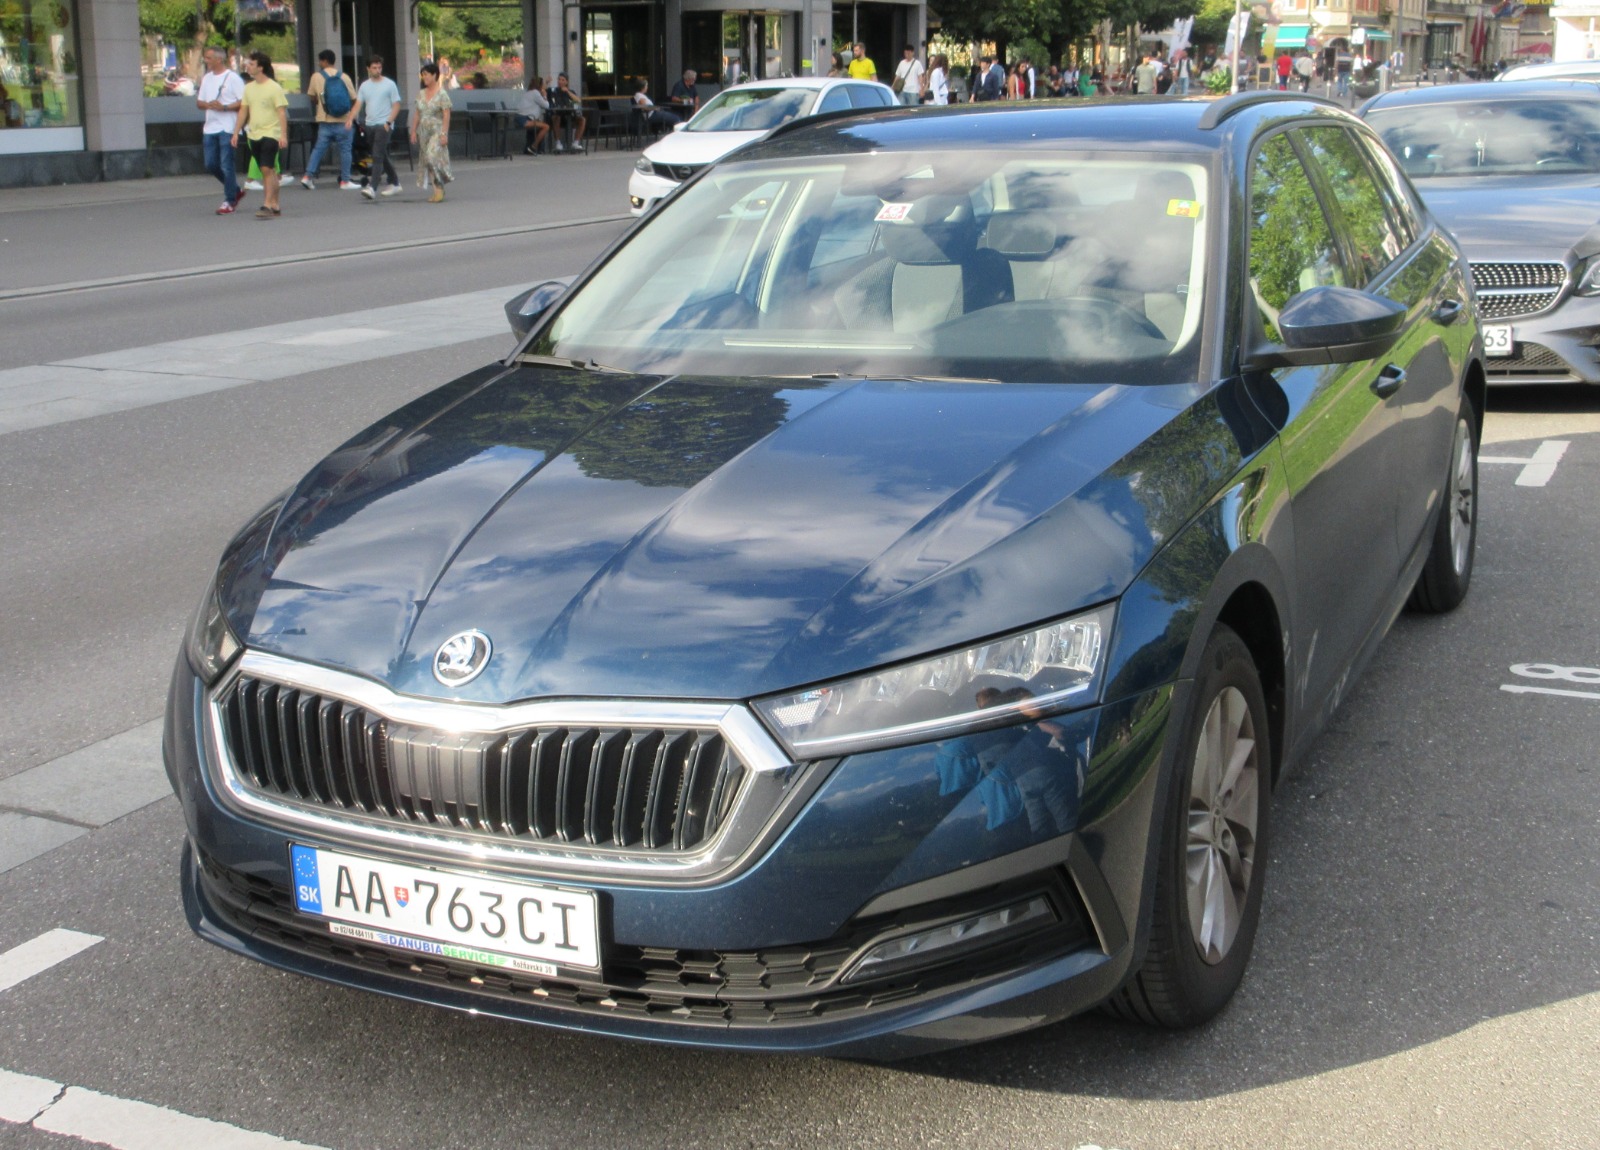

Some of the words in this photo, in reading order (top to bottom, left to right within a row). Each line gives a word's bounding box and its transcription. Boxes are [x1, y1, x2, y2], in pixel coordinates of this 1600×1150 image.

[1484, 329, 1508, 348] 63
[299, 885, 320, 904] SK
[334, 864, 391, 918] AA
[413, 879, 579, 951] 763CI
